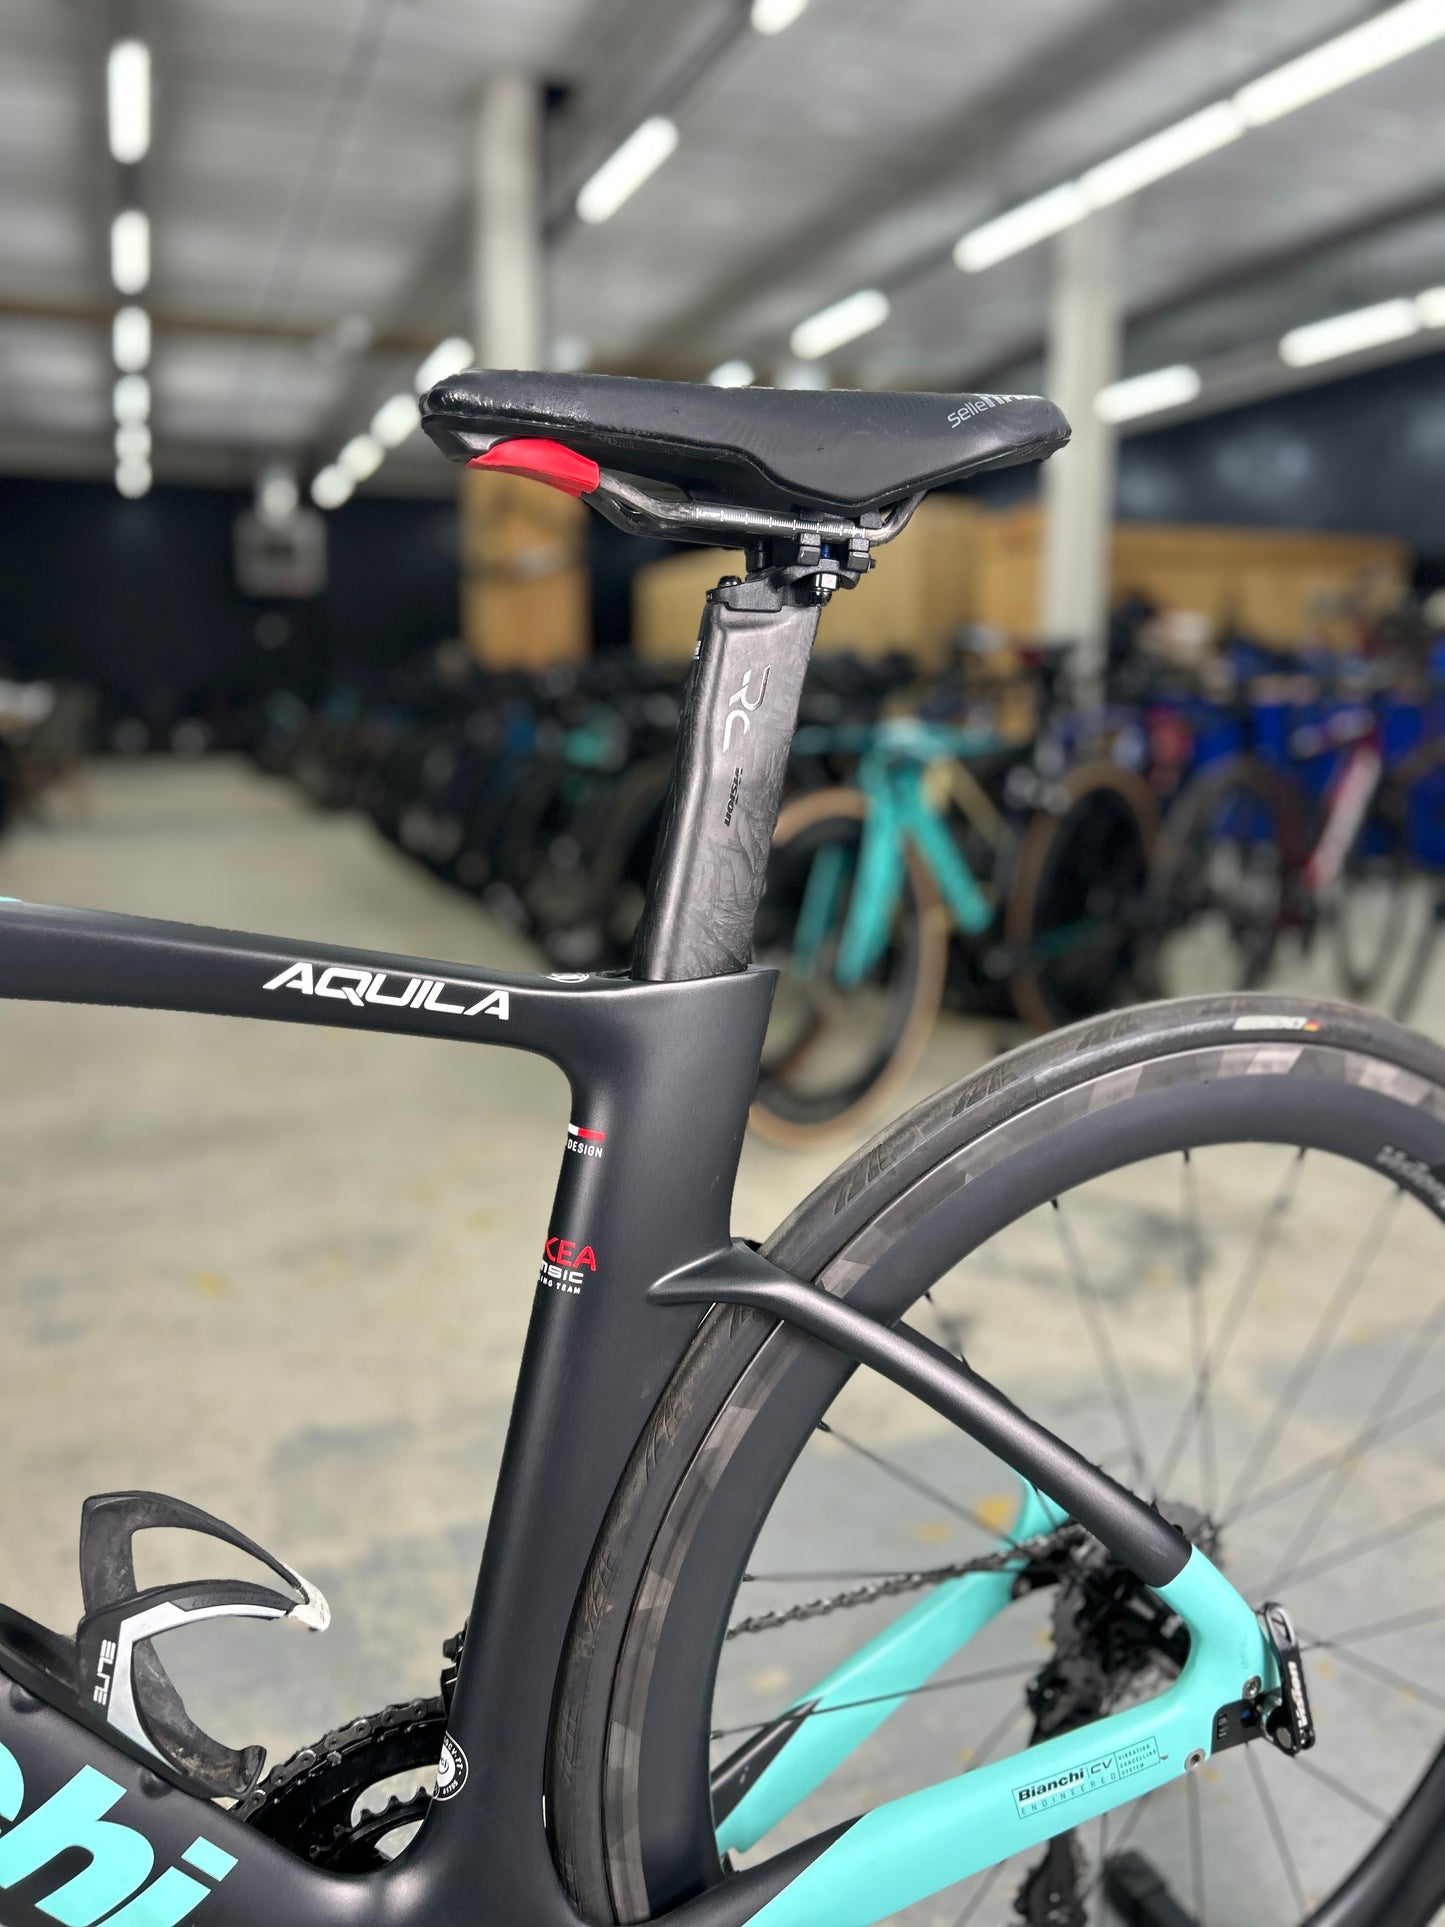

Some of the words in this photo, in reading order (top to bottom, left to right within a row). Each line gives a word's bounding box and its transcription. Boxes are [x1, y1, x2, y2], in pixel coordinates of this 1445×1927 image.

[947, 400, 988, 429] selle
[262, 962, 510, 1021] AQUILA
[567, 1138, 603, 1158] DESIGN
[556, 1281, 581, 1295] TEAM
[1018, 1767, 1085, 1802] Bianchi
[1090, 1758, 1113, 1775] CV
[1021, 1771, 1117, 1815] ENGINEERED
[0, 1741, 239, 1927] hi
